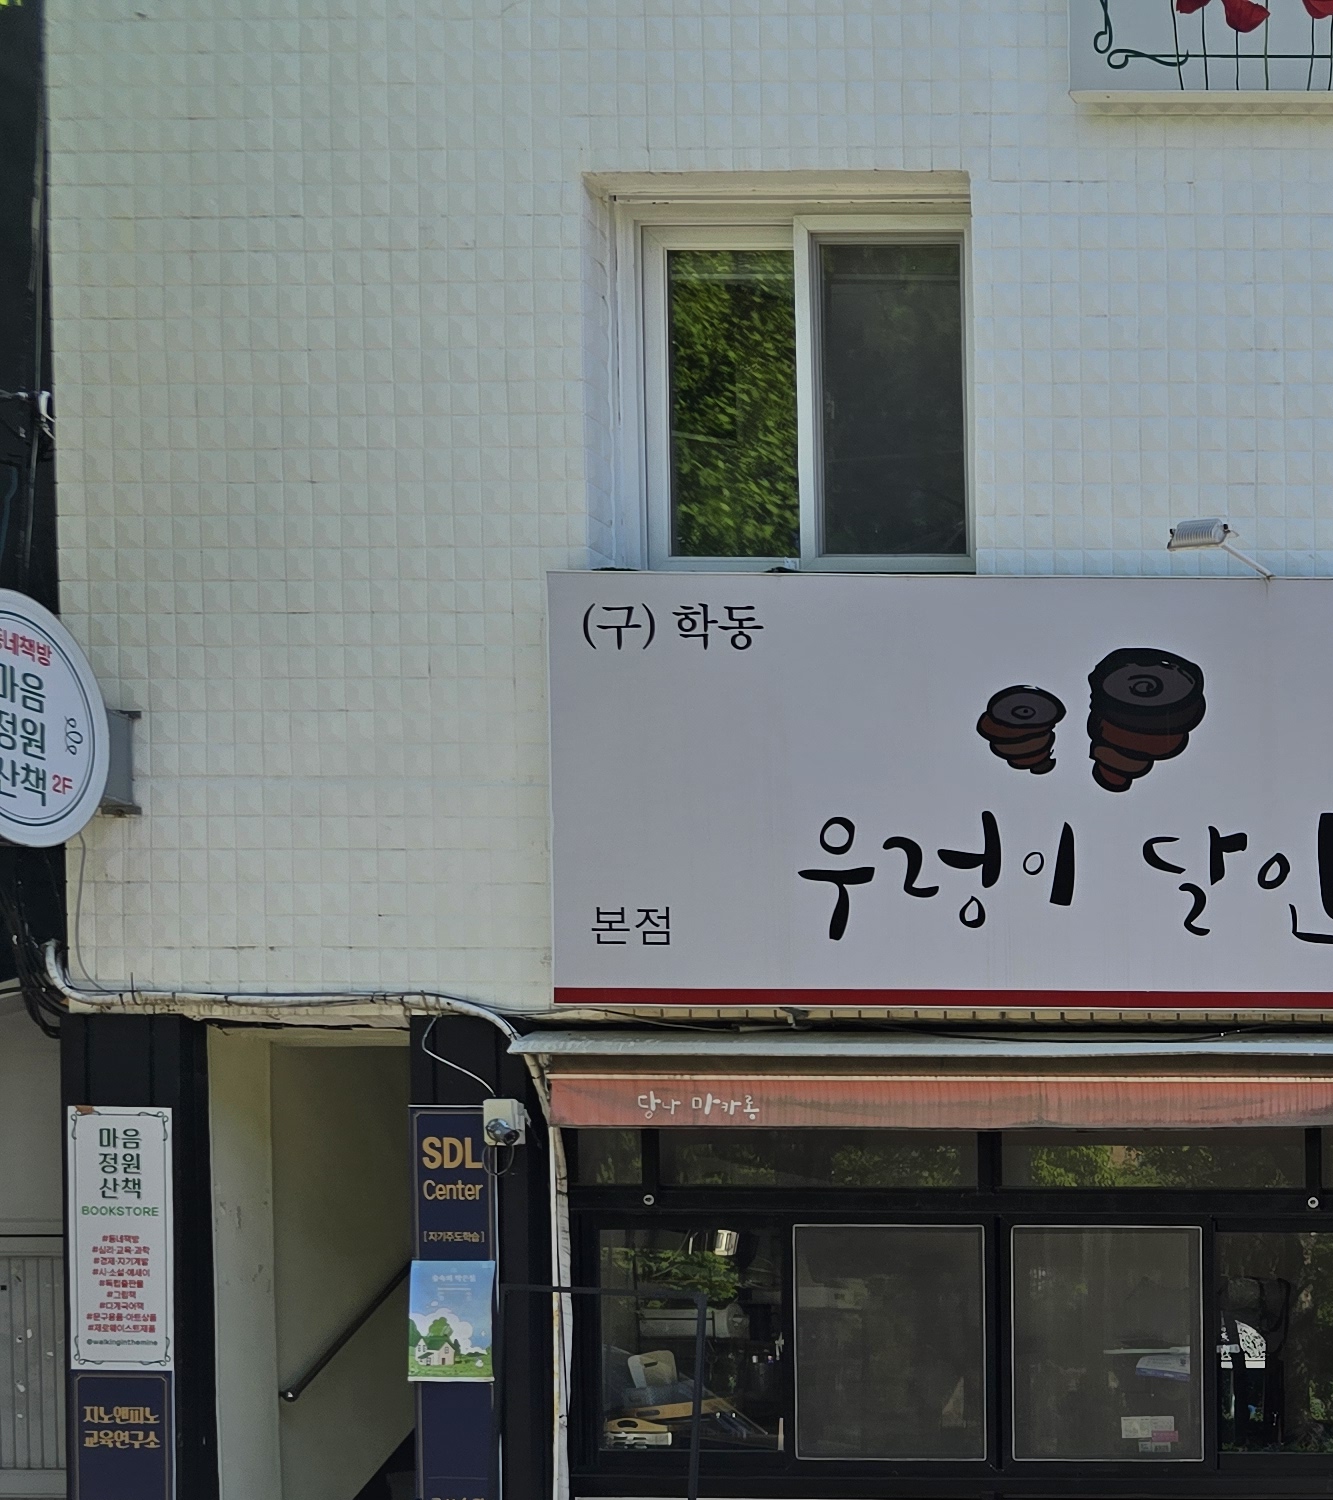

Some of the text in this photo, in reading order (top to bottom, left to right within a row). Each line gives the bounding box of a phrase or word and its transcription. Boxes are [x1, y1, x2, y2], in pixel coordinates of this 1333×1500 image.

[581, 602, 765, 652] (구) 학동
[52, 774, 73, 795] 2F
[798, 811, 1075, 941] 우렁이
[590, 904, 673, 948] 본점
[638, 1090, 760, 1120] 당나 마카롱
[99, 1127, 142, 1149] 마음
[99, 1153, 142, 1174] 정원
[422, 1136, 484, 1170] SDL
[99, 1178, 142, 1200] 산책
[423, 1179, 484, 1201] Center
[82, 1206, 159, 1217] BOOKSTORE
[83, 1406, 160, 1424] 지노앤피노
[83, 1430, 161, 1449] 교육연구소
